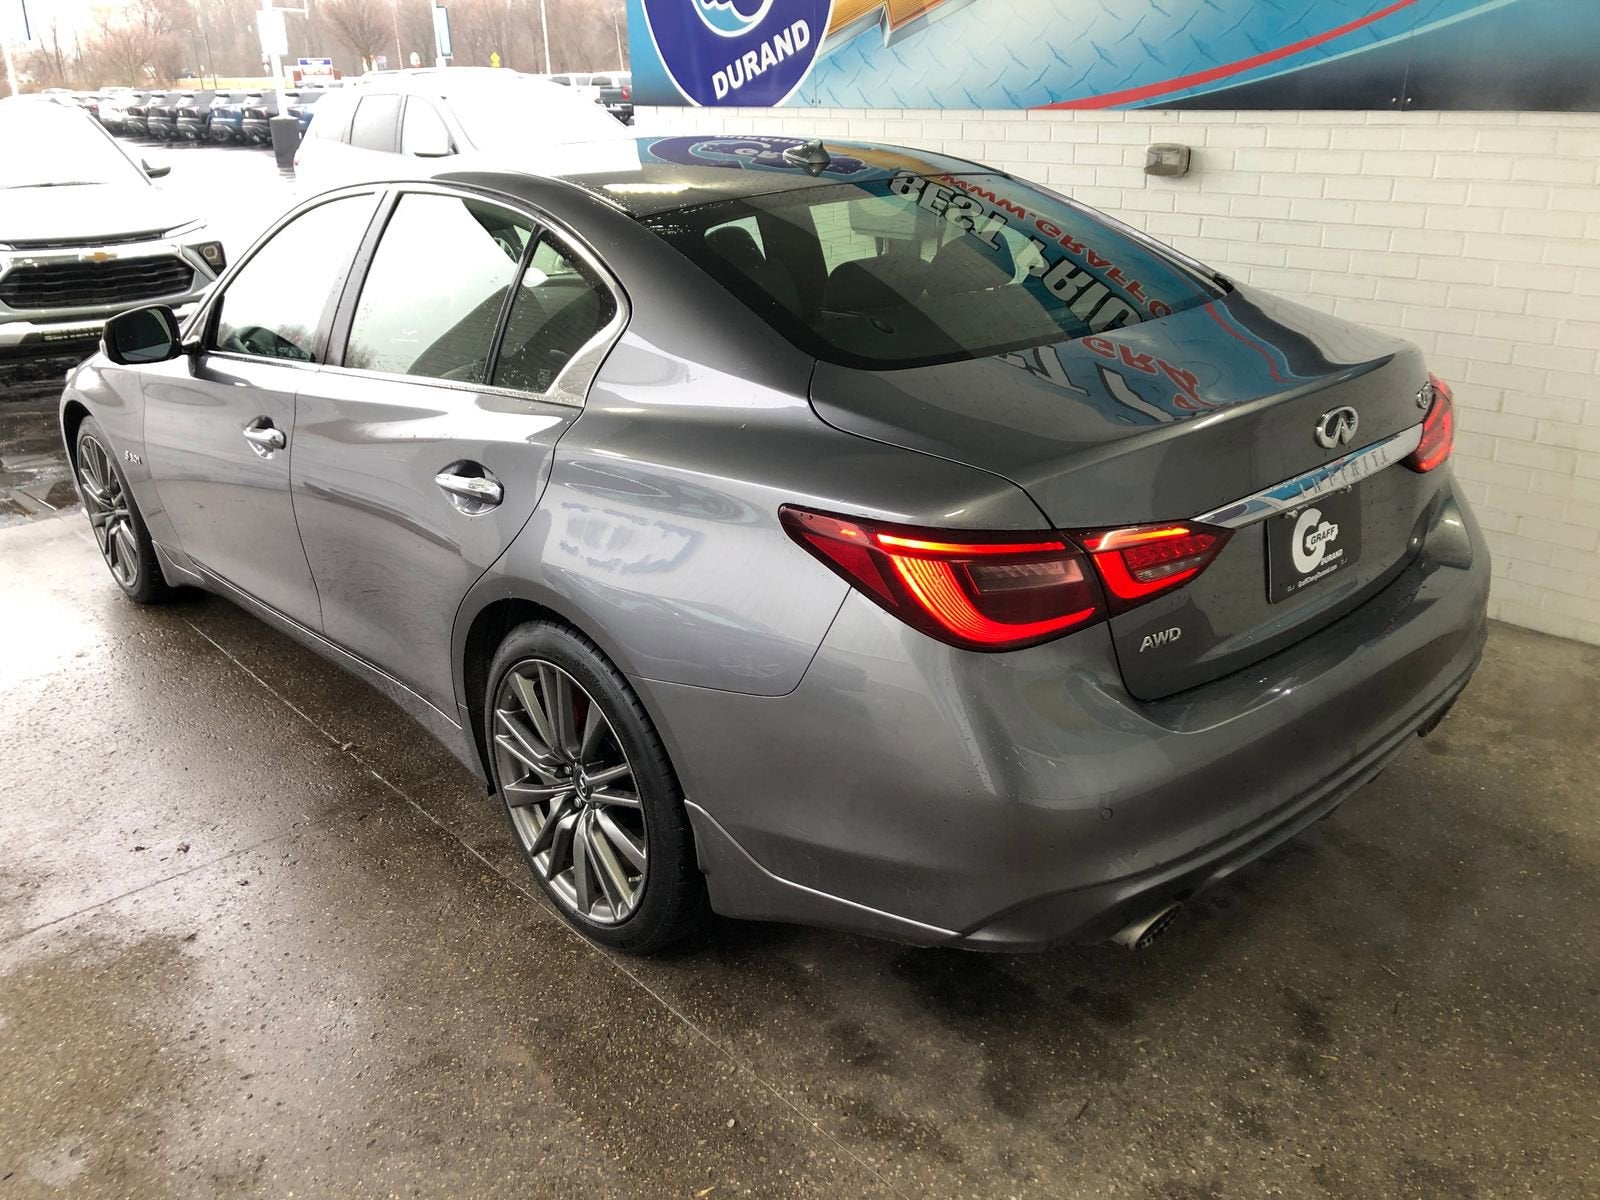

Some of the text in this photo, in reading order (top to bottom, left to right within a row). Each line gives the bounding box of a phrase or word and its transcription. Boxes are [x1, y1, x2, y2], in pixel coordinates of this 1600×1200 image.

[711, 19, 810, 100] DURAND
[1310, 526, 1336, 545] GRAFF
[1139, 626, 1181, 652] AWD
